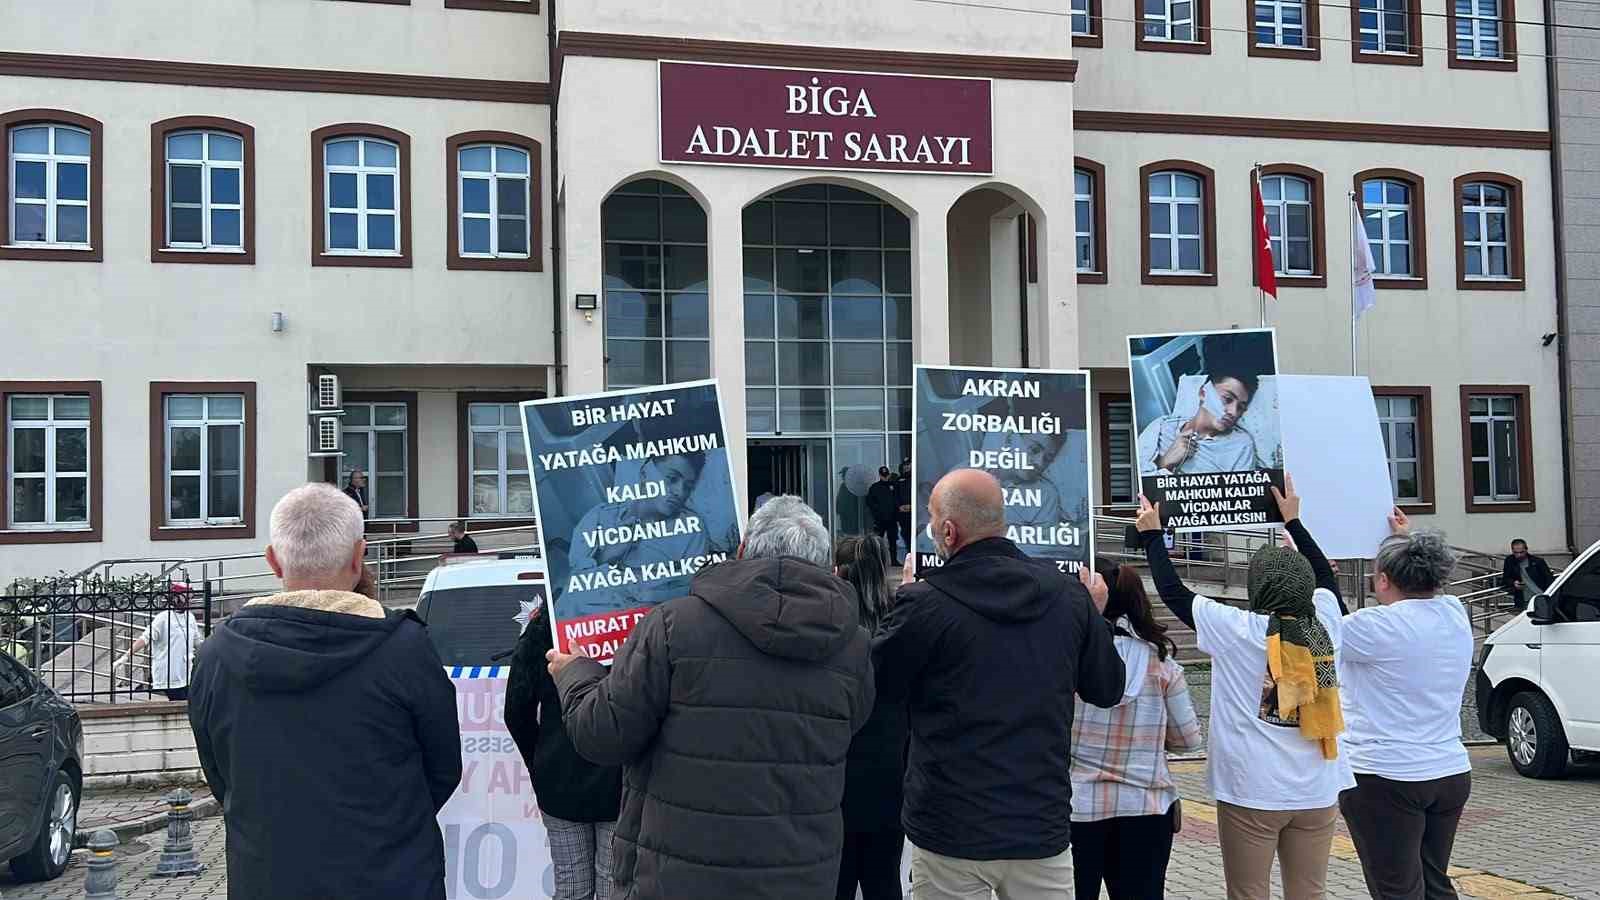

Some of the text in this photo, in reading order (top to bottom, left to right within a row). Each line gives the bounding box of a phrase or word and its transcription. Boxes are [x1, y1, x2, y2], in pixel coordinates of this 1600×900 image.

[785, 76, 877, 118] BİGA
[685, 125, 972, 165] ADALET SARAYI
[962, 378, 1041, 398] AKRAN
[571, 399, 676, 427] BİR HAYAT
[942, 412, 1061, 434] ZORBALIĞI
[539, 433, 718, 471] YATAĞA MAHKUM
[970, 448, 1034, 470] DEĞİL
[606, 480, 666, 504] KALDI
[1157, 471, 1271, 489] BİR HAYAT YATAĞA
[1166, 486, 1265, 501] MAHKUM KALDI!
[1180, 500, 1251, 514] VİCDANLAR
[1167, 513, 1209, 527] AYAĞA
[583, 517, 701, 548] VİCDANLAR
[568, 564, 638, 593] AYAĞA
[565, 615, 630, 640] MURAT
